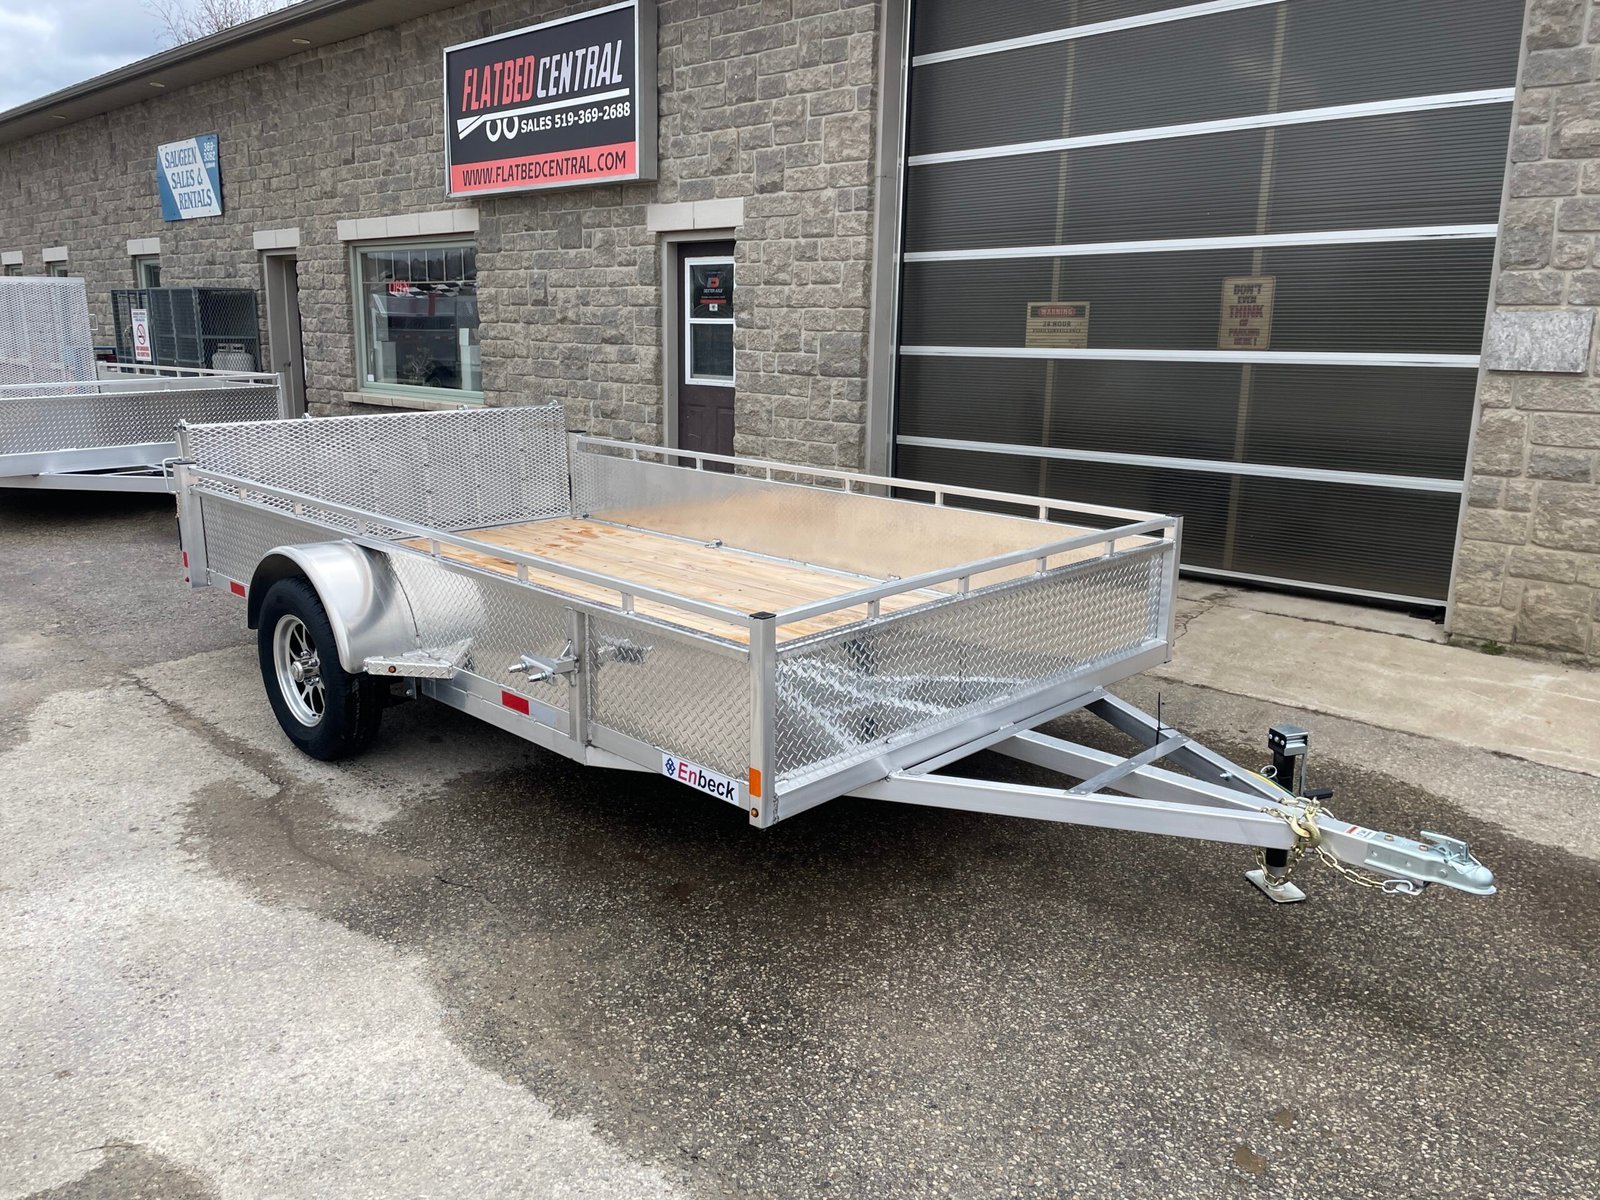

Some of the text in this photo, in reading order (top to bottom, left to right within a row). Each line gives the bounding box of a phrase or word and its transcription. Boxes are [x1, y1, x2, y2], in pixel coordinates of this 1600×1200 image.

[521, 101, 631, 133] SALES 519-369-2688
[165, 146, 197, 169] SAUGEEN
[462, 150, 627, 187] WWW.FLATBEDCENTRAL.COM
[171, 168, 203, 190] SALES &
[178, 189, 212, 210] RENTALS
[1040, 308, 1074, 316] WARNING
[1228, 305, 1265, 319] THINK
[1052, 320, 1072, 328] HOUR
[677, 761, 735, 801] Enbeck
